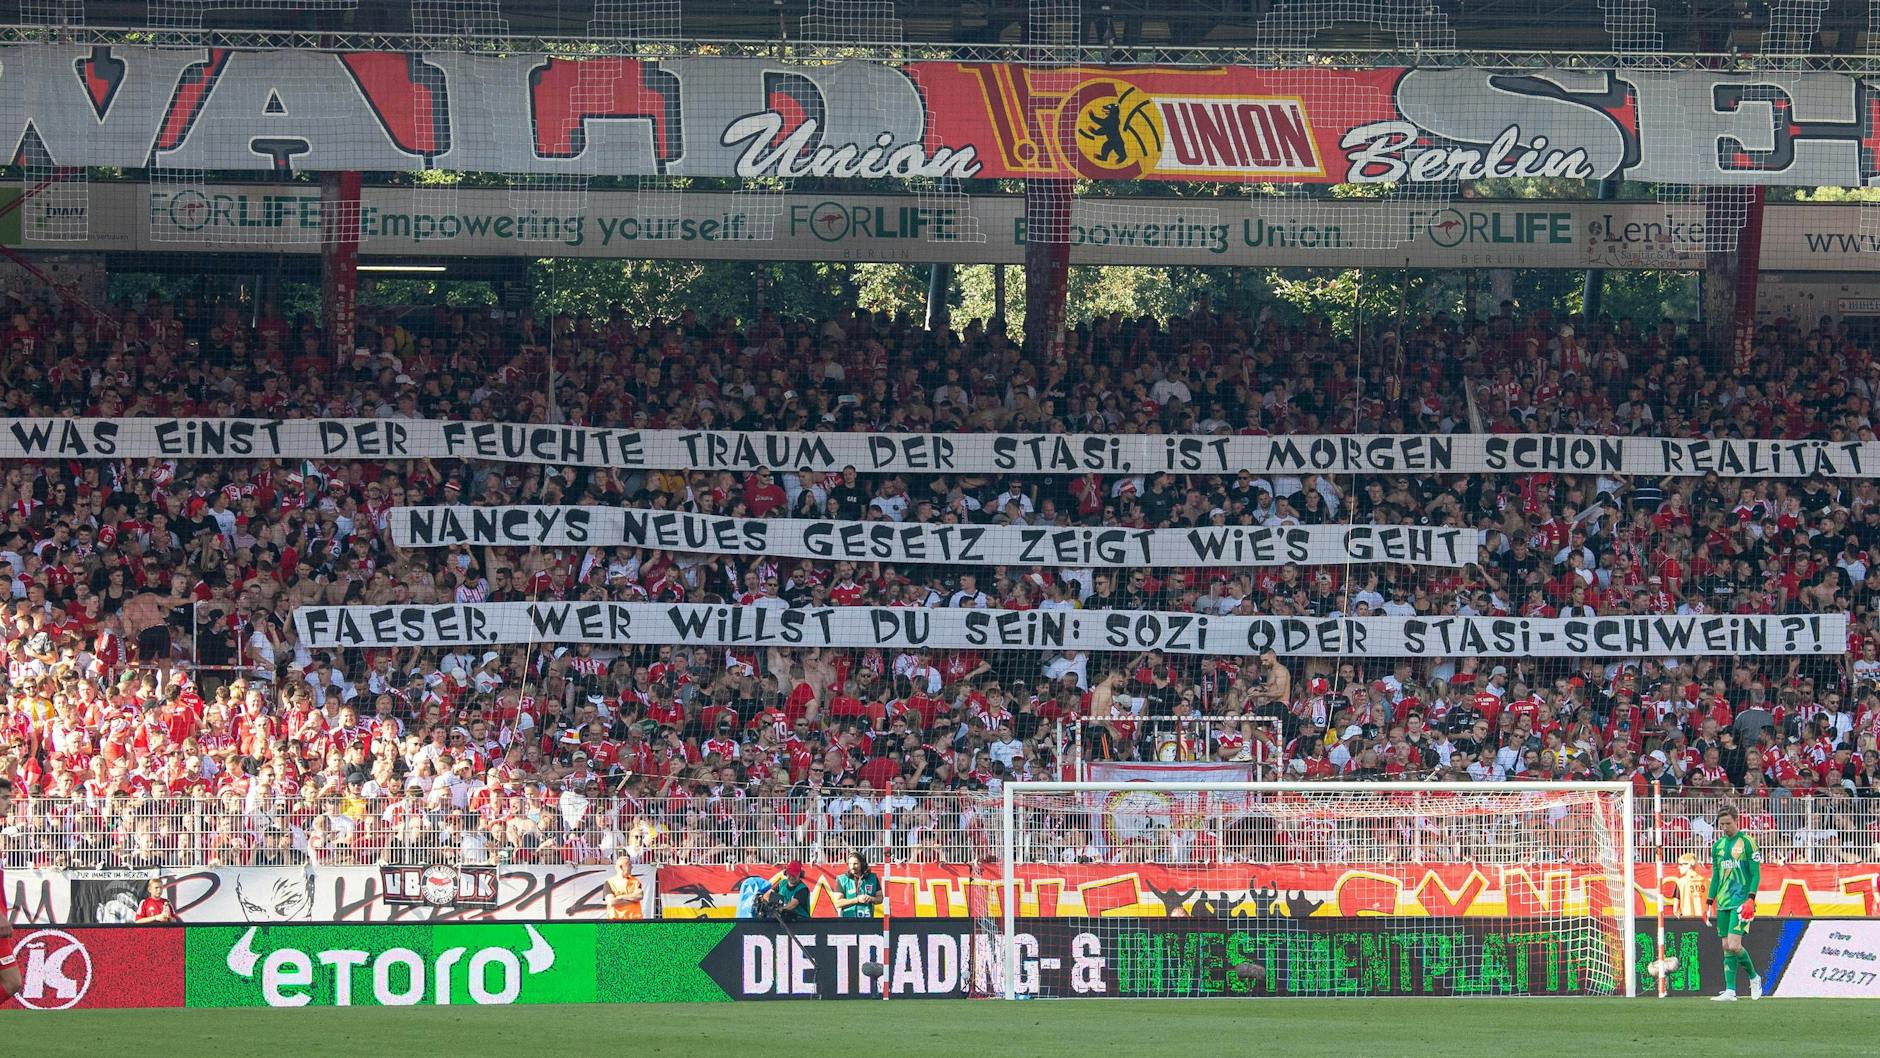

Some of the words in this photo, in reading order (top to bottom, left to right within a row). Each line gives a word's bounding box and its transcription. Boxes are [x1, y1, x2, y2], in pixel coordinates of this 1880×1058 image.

[723, 112, 981, 178] Union
[1341, 122, 1594, 182] Berlin
[1162, 102, 1319, 170] UNION
[360, 207, 586, 246] Empowering
[597, 212, 756, 247] yourself.
[1243, 218, 1353, 248] Union.
[1603, 214, 1704, 243] Lenke
[843, 249, 910, 258] BERLIN
[1461, 255, 1527, 264] BERLIN
[10, 420, 118, 455] WAS
[319, 421, 407, 455] DER
[443, 422, 644, 464] FEUCHTE
[678, 433, 835, 468] TRAUM
[868, 436, 954, 469] DER
[1266, 437, 1452, 471] MORGEN
[1486, 436, 1622, 471] SCHON
[410, 508, 590, 543] NANCYS
[623, 511, 767, 550] NEUES
[803, 522, 985, 560] GESETZ
[1344, 528, 1460, 563] GEHT
[306, 606, 497, 644] FAESER,
[527, 604, 630, 639] WER
[871, 610, 929, 644] DU
[1248, 619, 1366, 653] ODER
[1781, 616, 1821, 651] ?!
[743, 934, 817, 994] DIE
[1071, 932, 1107, 994] &
